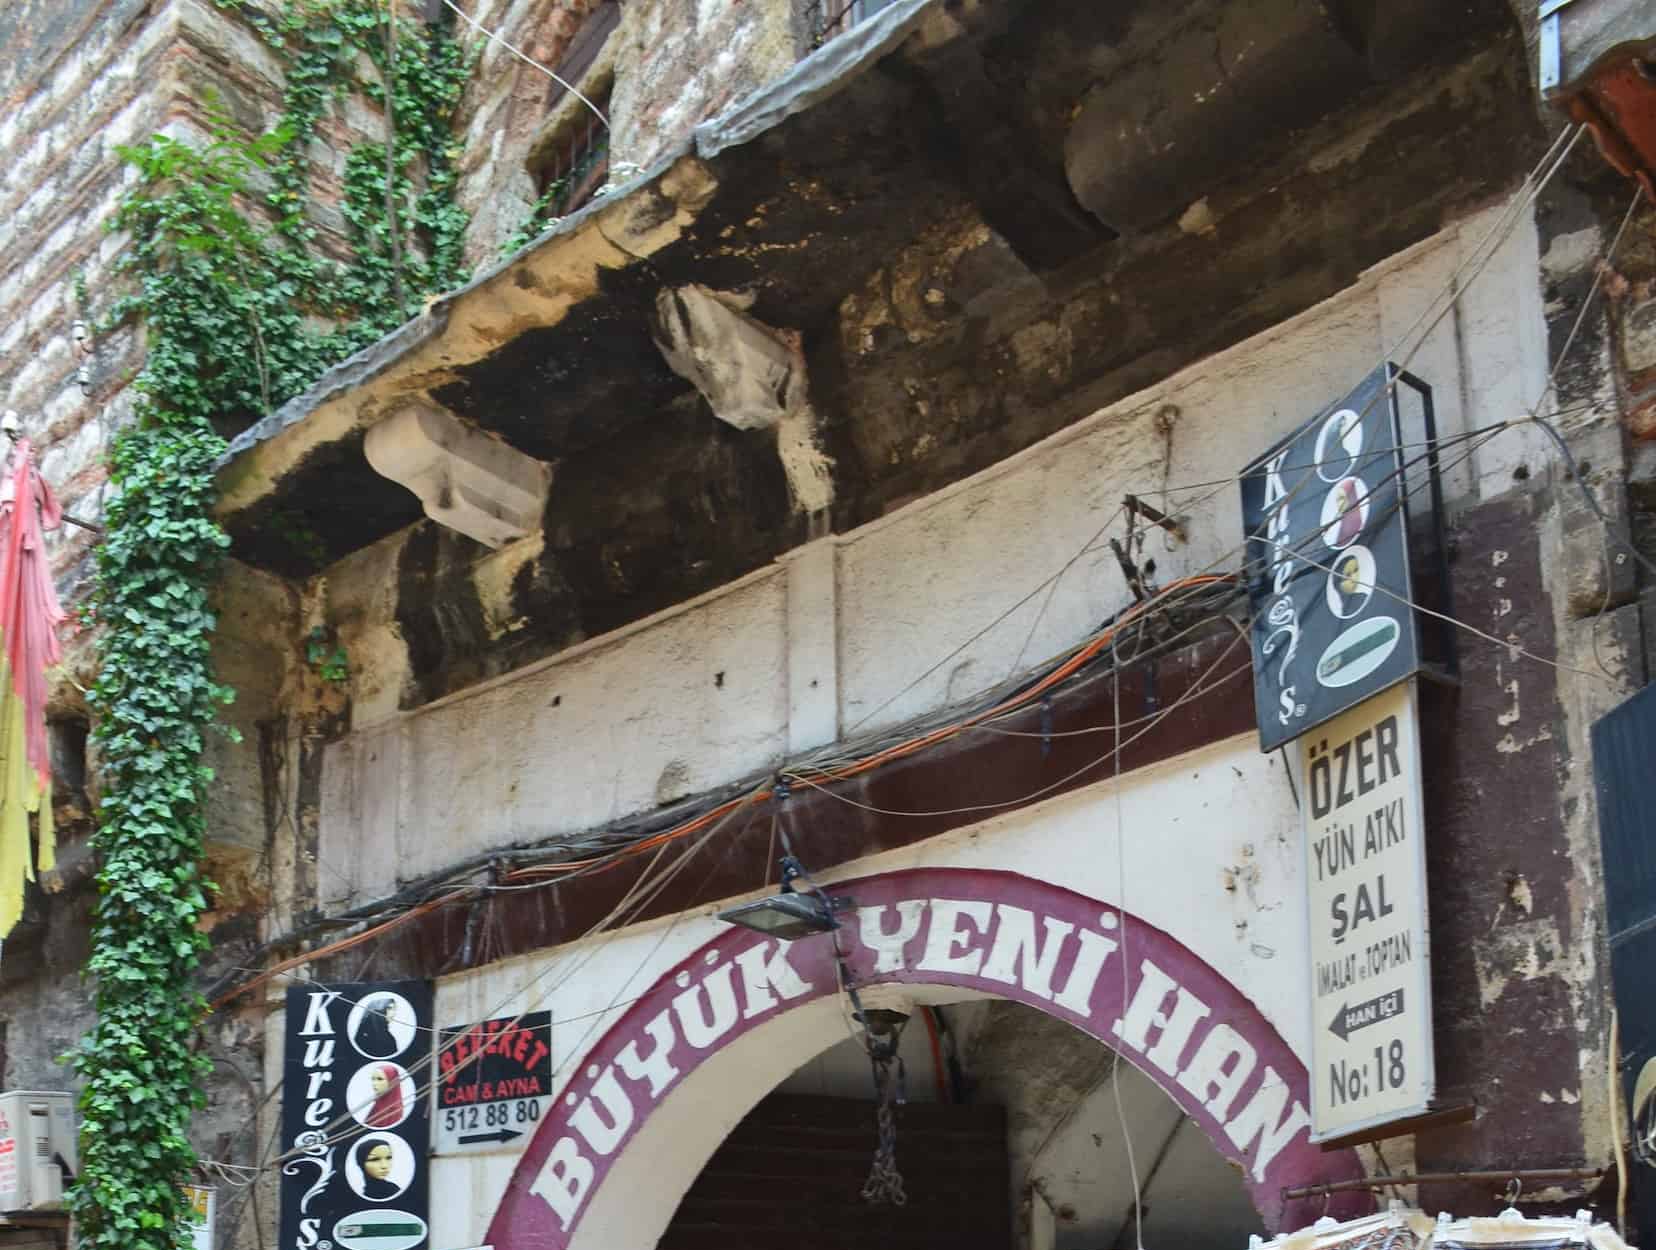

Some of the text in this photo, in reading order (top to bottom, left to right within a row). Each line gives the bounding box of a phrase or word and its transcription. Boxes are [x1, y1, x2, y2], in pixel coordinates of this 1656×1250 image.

[1309, 715, 1402, 820] ÖZER
[1313, 797, 1405, 881] YÜN ATKI
[1331, 874, 1394, 944] ŞAL
[1367, 929, 1412, 977] TOPTAN
[1345, 1005, 1376, 1028] HAN
[440, 1019, 550, 1084] BEREKET
[528, 898, 1313, 1232] BÜYÜK YENİ HAN
[1330, 1039, 1405, 1108] No: 18
[445, 1098, 540, 1131] 512 88 80
[481, 1082, 493, 1100] &
[495, 1075, 540, 1099] AYNA
